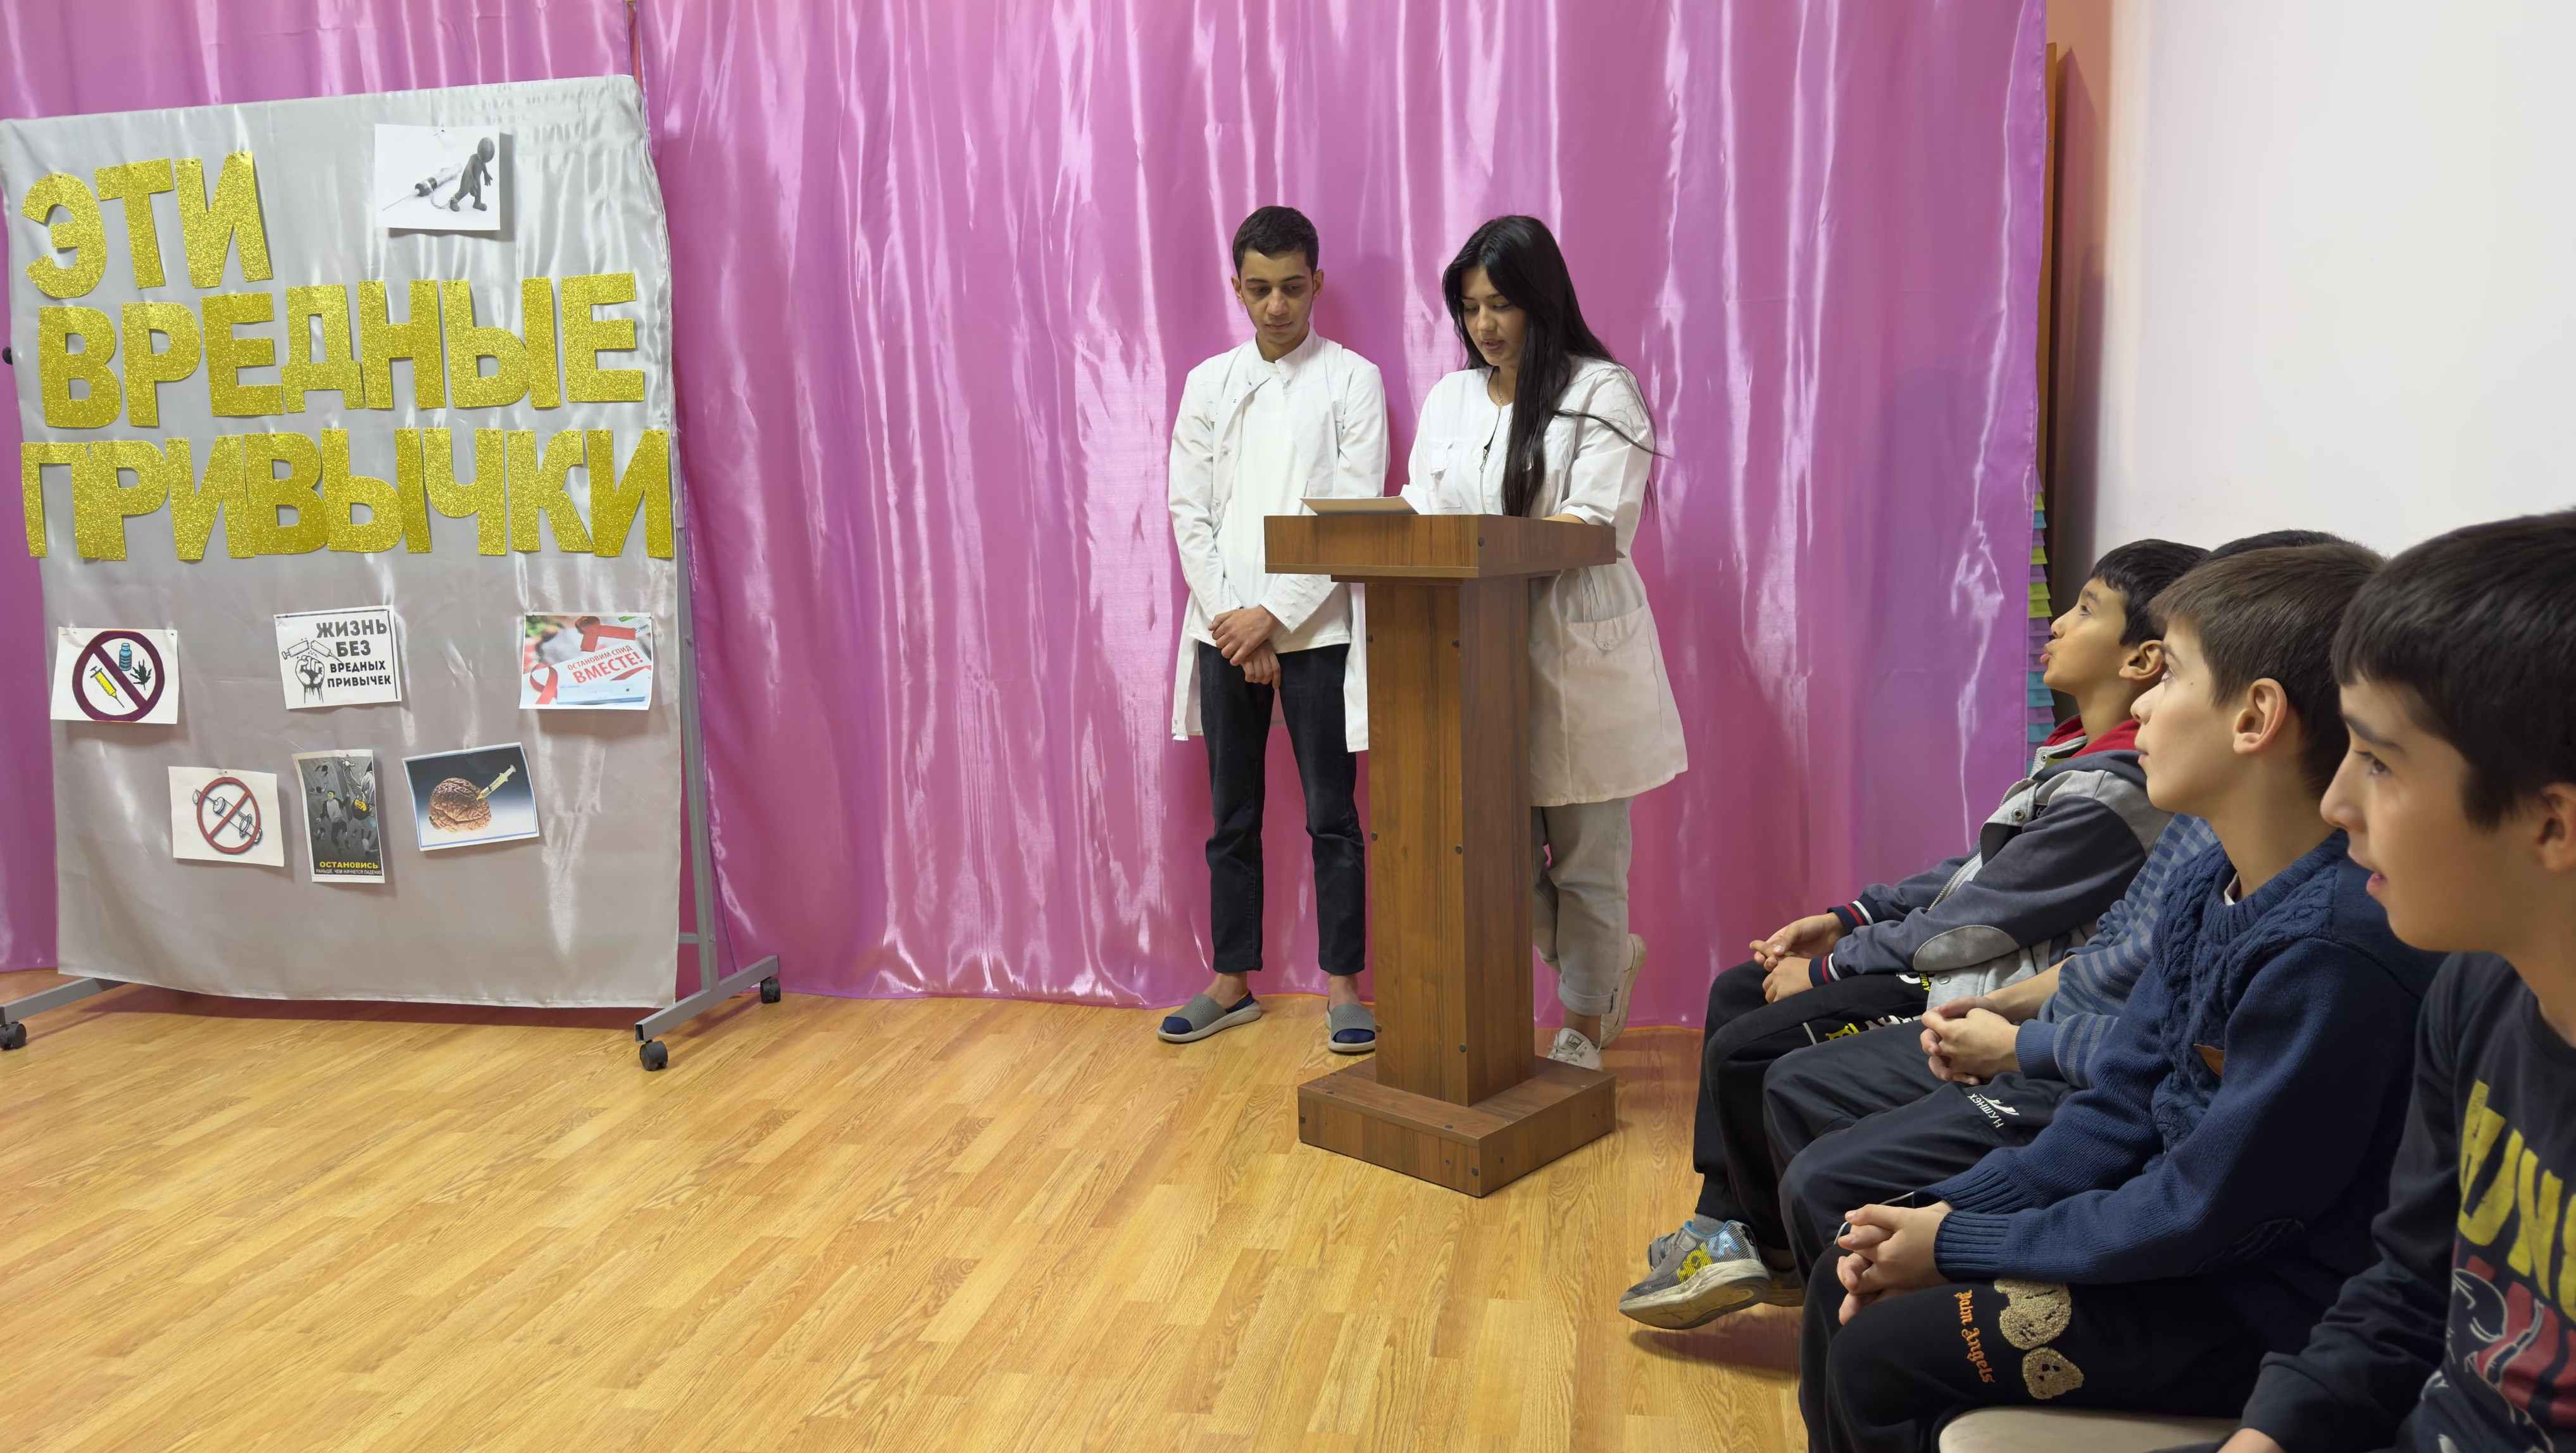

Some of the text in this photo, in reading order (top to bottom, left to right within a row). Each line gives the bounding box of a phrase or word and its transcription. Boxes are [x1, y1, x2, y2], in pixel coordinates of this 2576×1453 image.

[21, 150, 273, 299] ЭТИ
[38, 271, 645, 428] ВРЕДНЫЕ
[20, 427, 674, 561] ПРИВЫЧКИ
[316, 619, 387, 638] ЖИЗНЬ
[335, 640, 372, 657] БЕЗ
[567, 645, 633, 671] ОСТАНОВИМ СПИД
[330, 660, 386, 673] ВРЕДНЫХ
[572, 651, 644, 683] ВМЕСТЕ!
[327, 675, 392, 688] ПРИВЫЧЕК
[319, 861, 379, 869] ОСТАНОВИСЬ
[1953, 1289, 1996, 1383] Palm Angels
